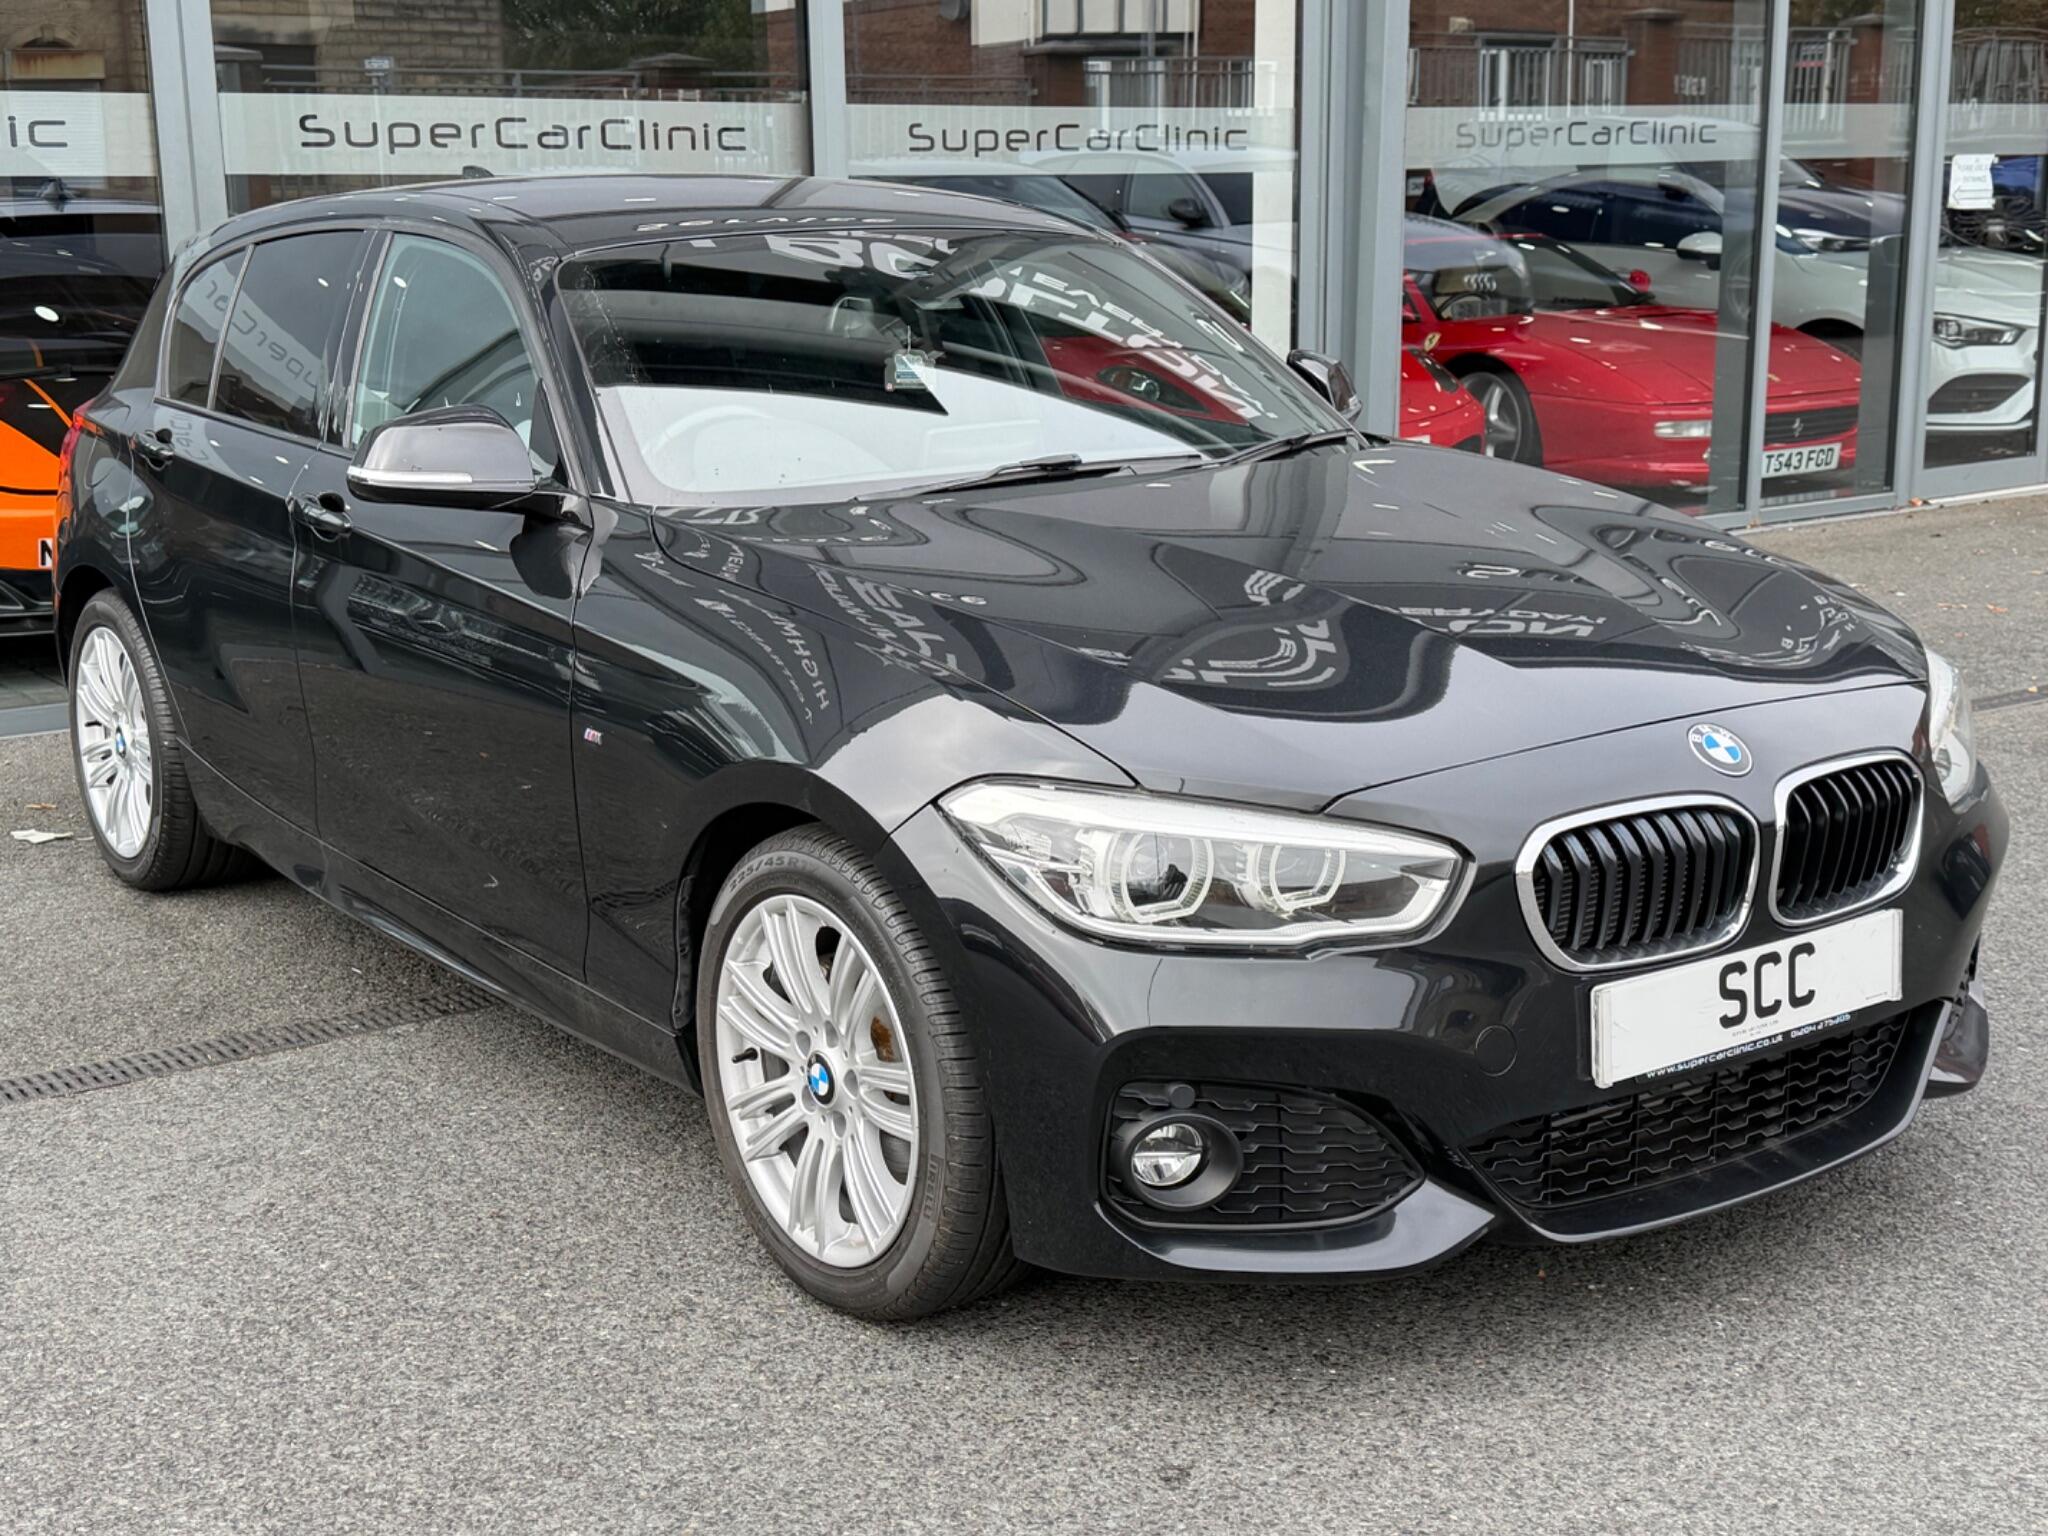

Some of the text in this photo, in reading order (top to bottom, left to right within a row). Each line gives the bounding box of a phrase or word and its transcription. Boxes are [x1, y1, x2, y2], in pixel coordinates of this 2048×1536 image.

[299, 114, 747, 154] SuperCarClinic
[908, 123, 1248, 157] SuperCarClinic
[1456, 121, 1717, 151] SuperCarClinic
[1765, 447, 1835, 474] T543 FGD
[1719, 941, 1816, 1029] SCC
